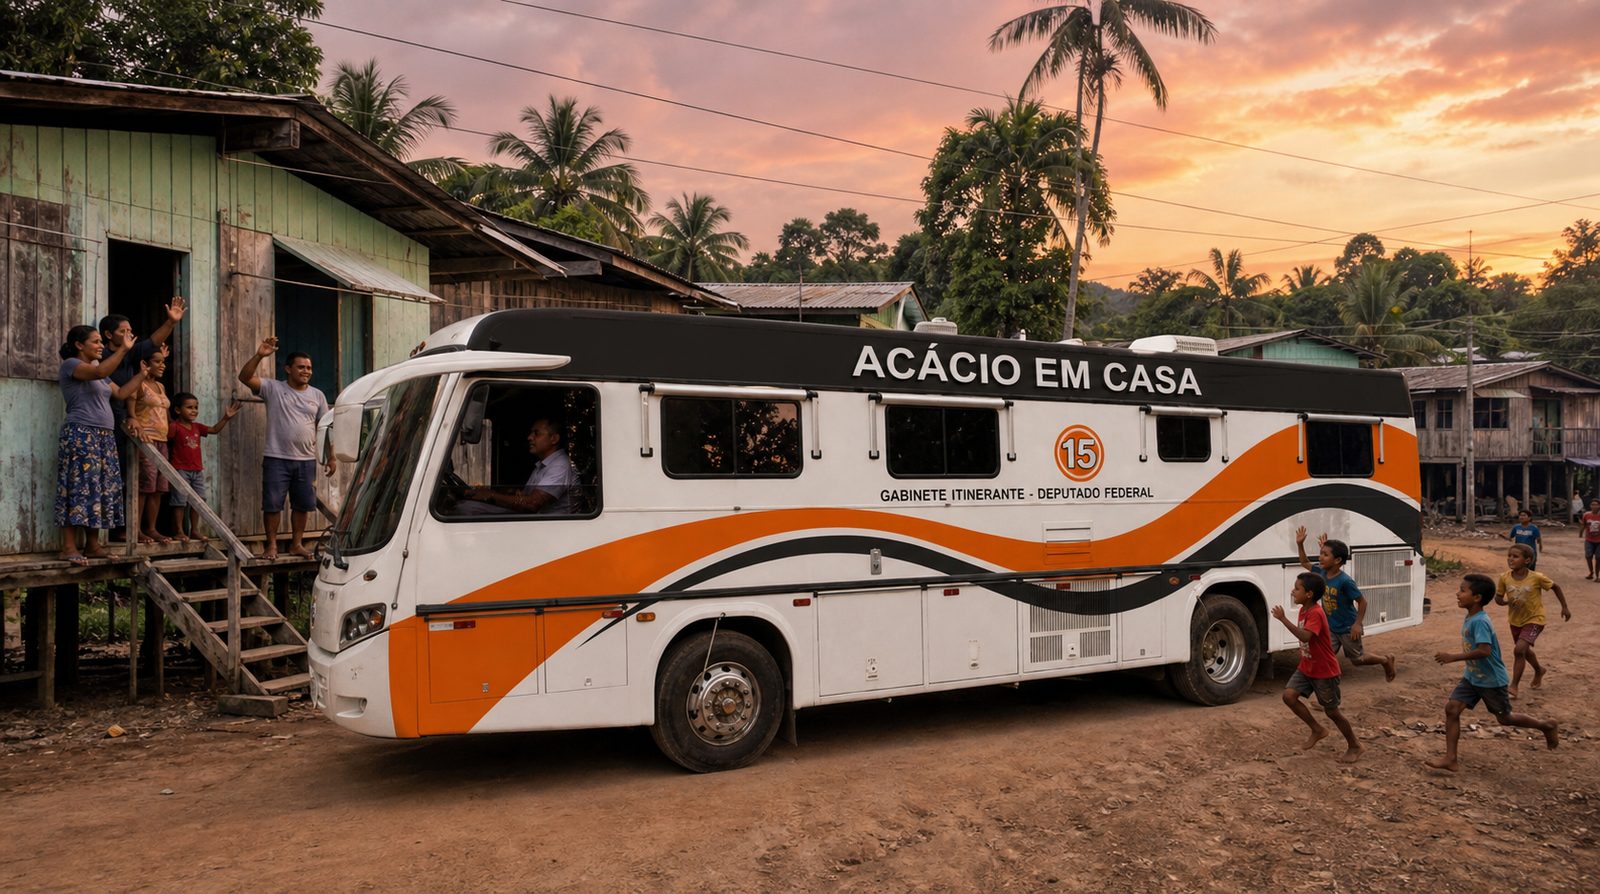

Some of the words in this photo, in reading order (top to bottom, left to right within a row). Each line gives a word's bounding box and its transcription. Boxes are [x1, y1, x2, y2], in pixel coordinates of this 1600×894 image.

[852, 343, 1021, 386] ACÁCIO
[1034, 357, 1091, 390] EM
[1103, 362, 1203, 396] CASA
[1061, 437, 1099, 470] 15
[880, 488, 947, 502] GABINETE
[951, 487, 1025, 501] ITINERANTE
[1037, 487, 1101, 500] DEPUTADO
[1104, 486, 1154, 499] FEDERAL
